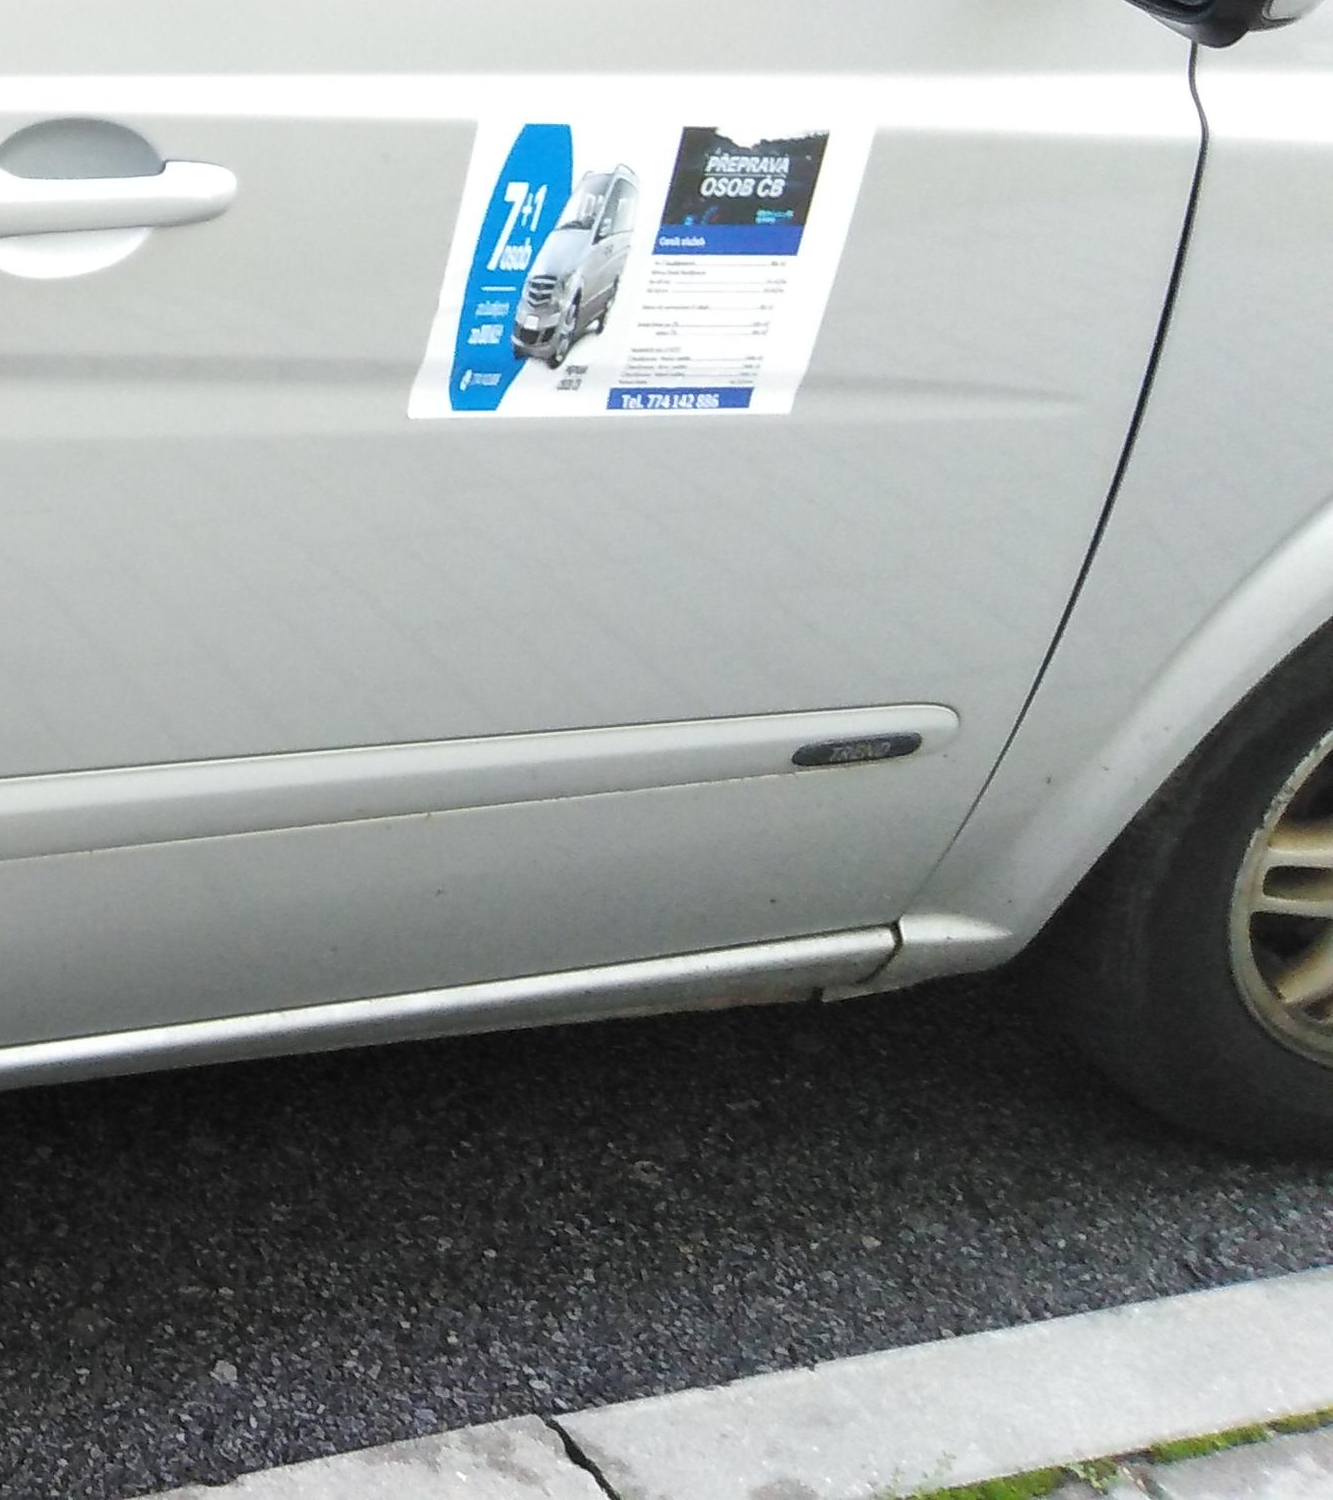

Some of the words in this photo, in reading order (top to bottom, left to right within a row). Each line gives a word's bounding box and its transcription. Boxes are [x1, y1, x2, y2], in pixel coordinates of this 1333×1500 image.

[704, 152, 790, 174] PŘEPRAVA
[700, 177, 755, 197] OSOB
[756, 175, 786, 197] ČB
[646, 393, 671, 409] 774
